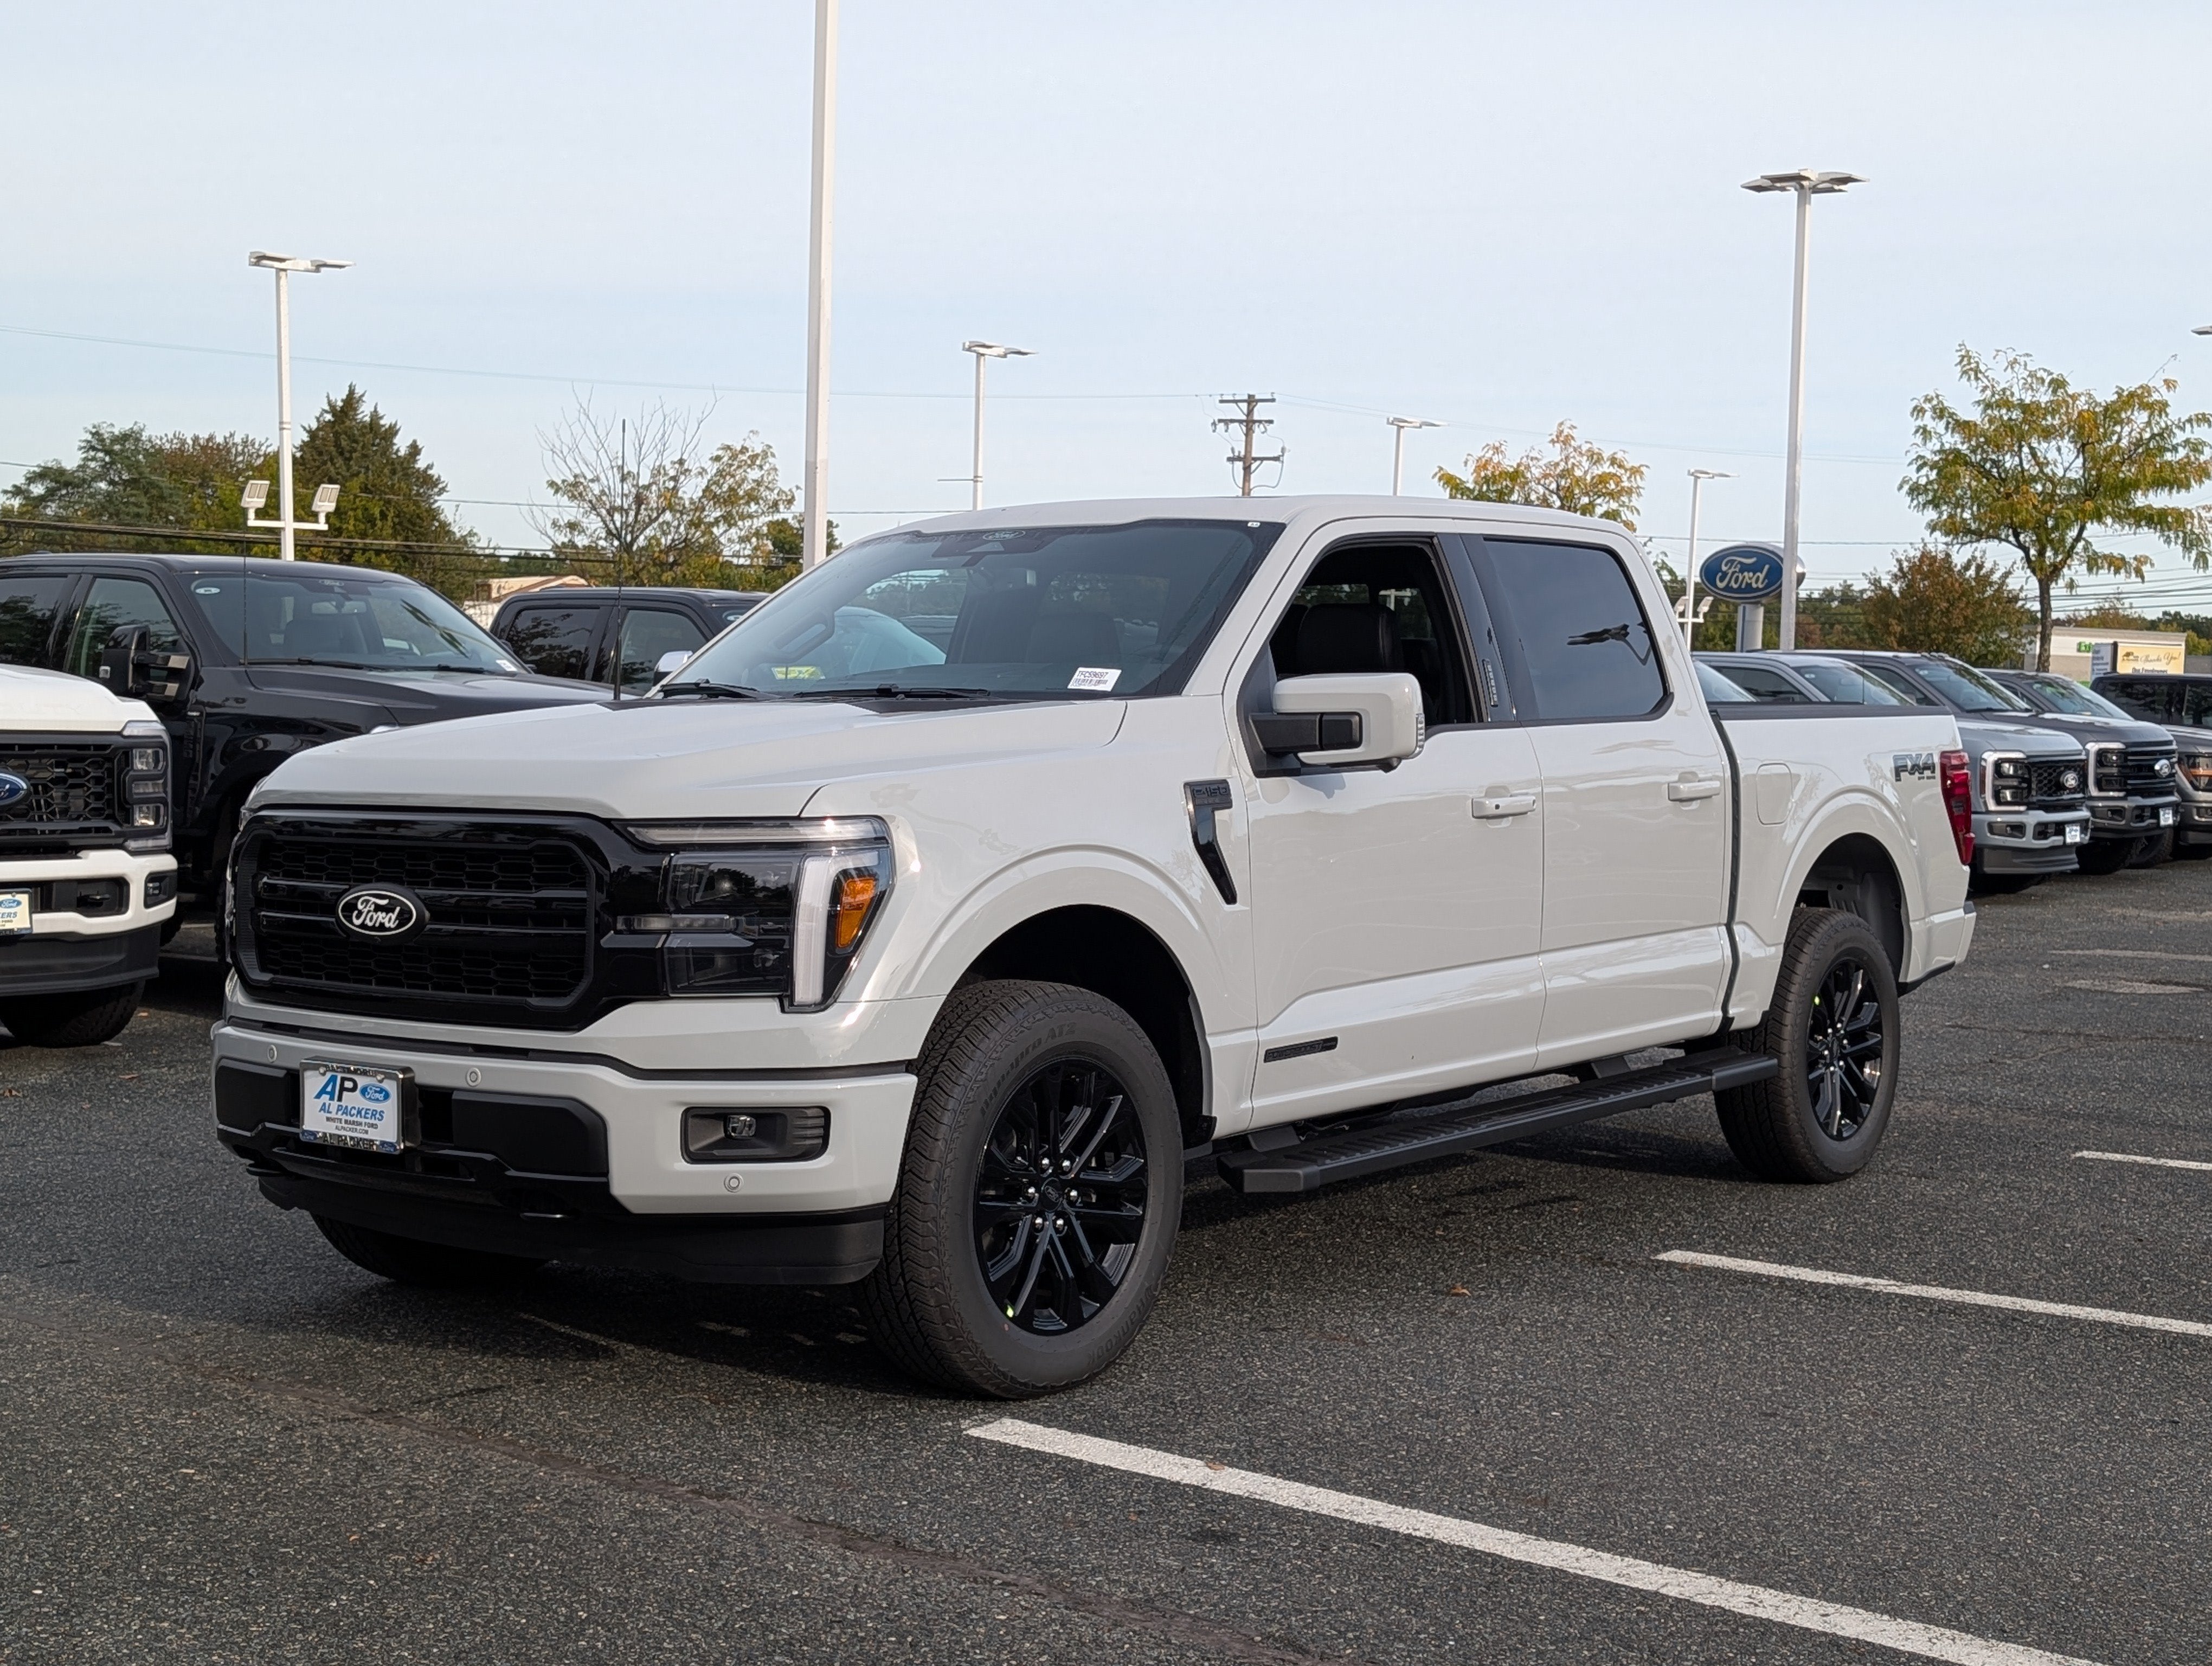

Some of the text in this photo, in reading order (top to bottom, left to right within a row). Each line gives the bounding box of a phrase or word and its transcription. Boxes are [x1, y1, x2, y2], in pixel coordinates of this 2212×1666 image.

[1716, 556, 1770, 589] Ford
[1893, 753, 1935, 781] FX4
[352, 896, 401, 928] Ford
[313, 1074, 385, 1102] AP Ford
[319, 1102, 385, 1121] AL PACKERS
[326, 1116, 343, 1124] WHITE
[344, 1119, 363, 1127] MARSH
[335, 1125, 369, 1135] ALPACKER.COM
